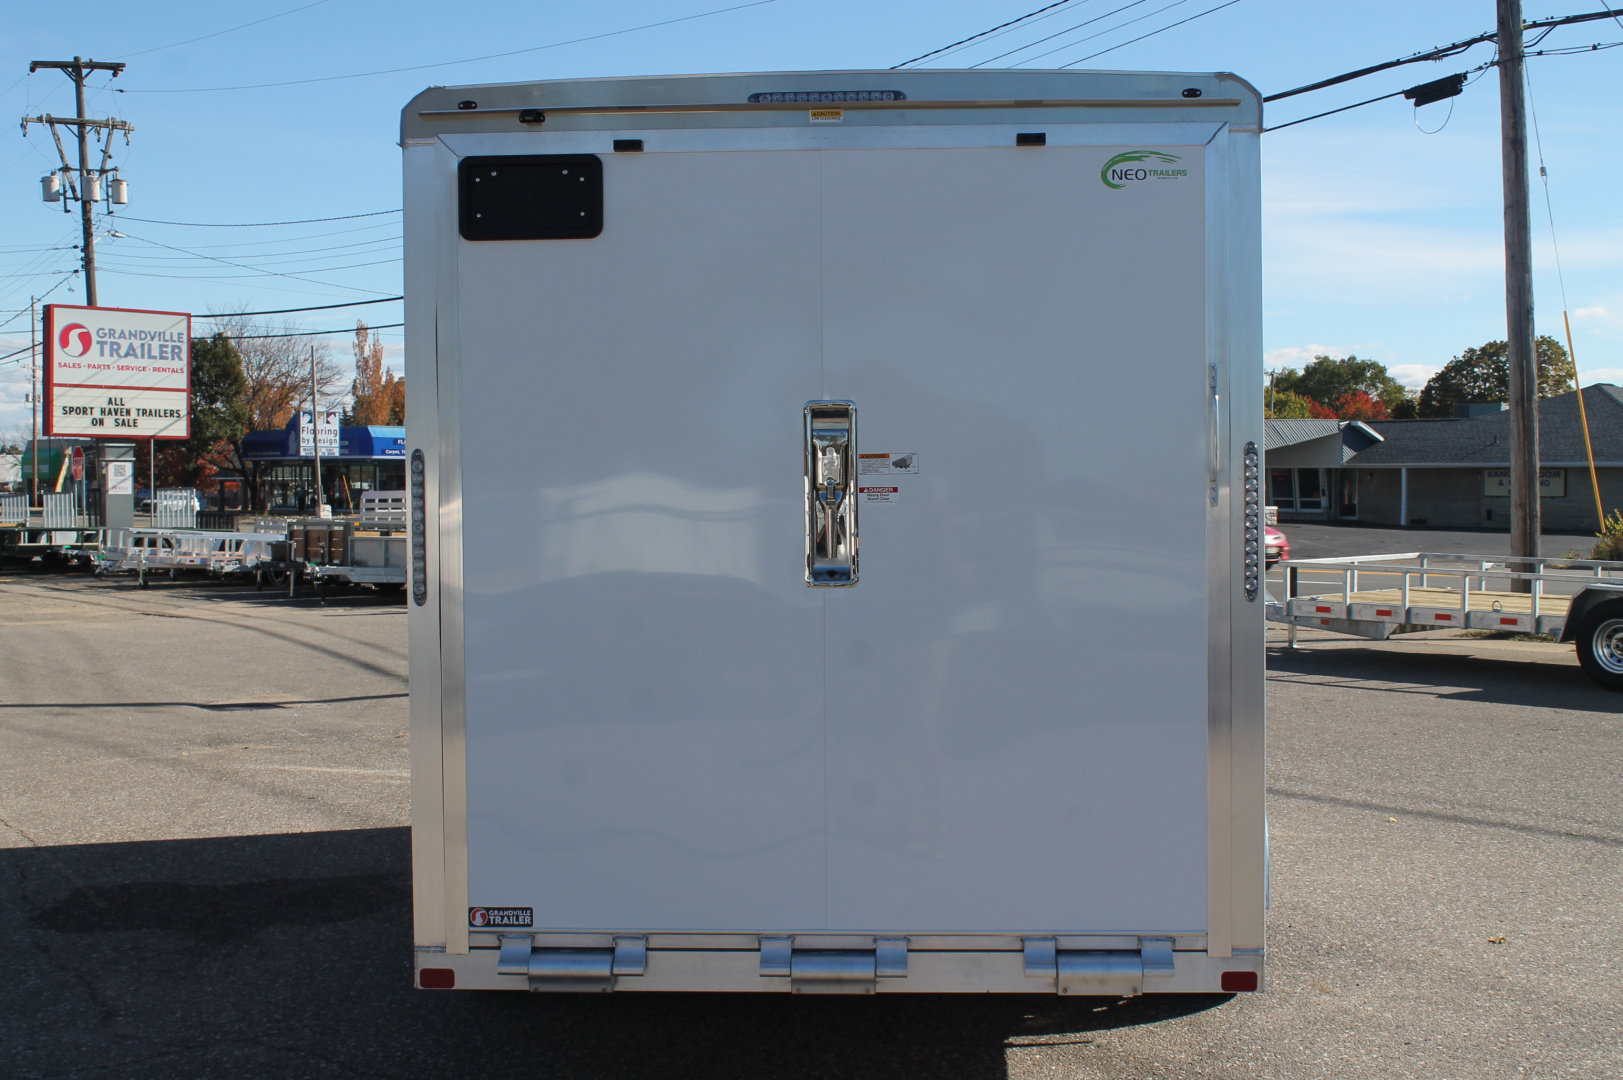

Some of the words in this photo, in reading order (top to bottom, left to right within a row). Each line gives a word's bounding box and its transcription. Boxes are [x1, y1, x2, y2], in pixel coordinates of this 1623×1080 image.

[1111, 168, 1147, 180] NEO
[96, 327, 184, 344] GRANDVILLE
[96, 340, 184, 361] TRAILER
[108, 397, 125, 406] ALL
[62, 406, 94, 416] SPORT
[100, 408, 131, 416] HAVEN
[136, 408, 181, 418] TRAILERS
[91, 418, 104, 426] ON
[114, 418, 138, 427] SALE
[73, 457, 84, 469] STOP
[489, 916, 532, 924] TRAILER
